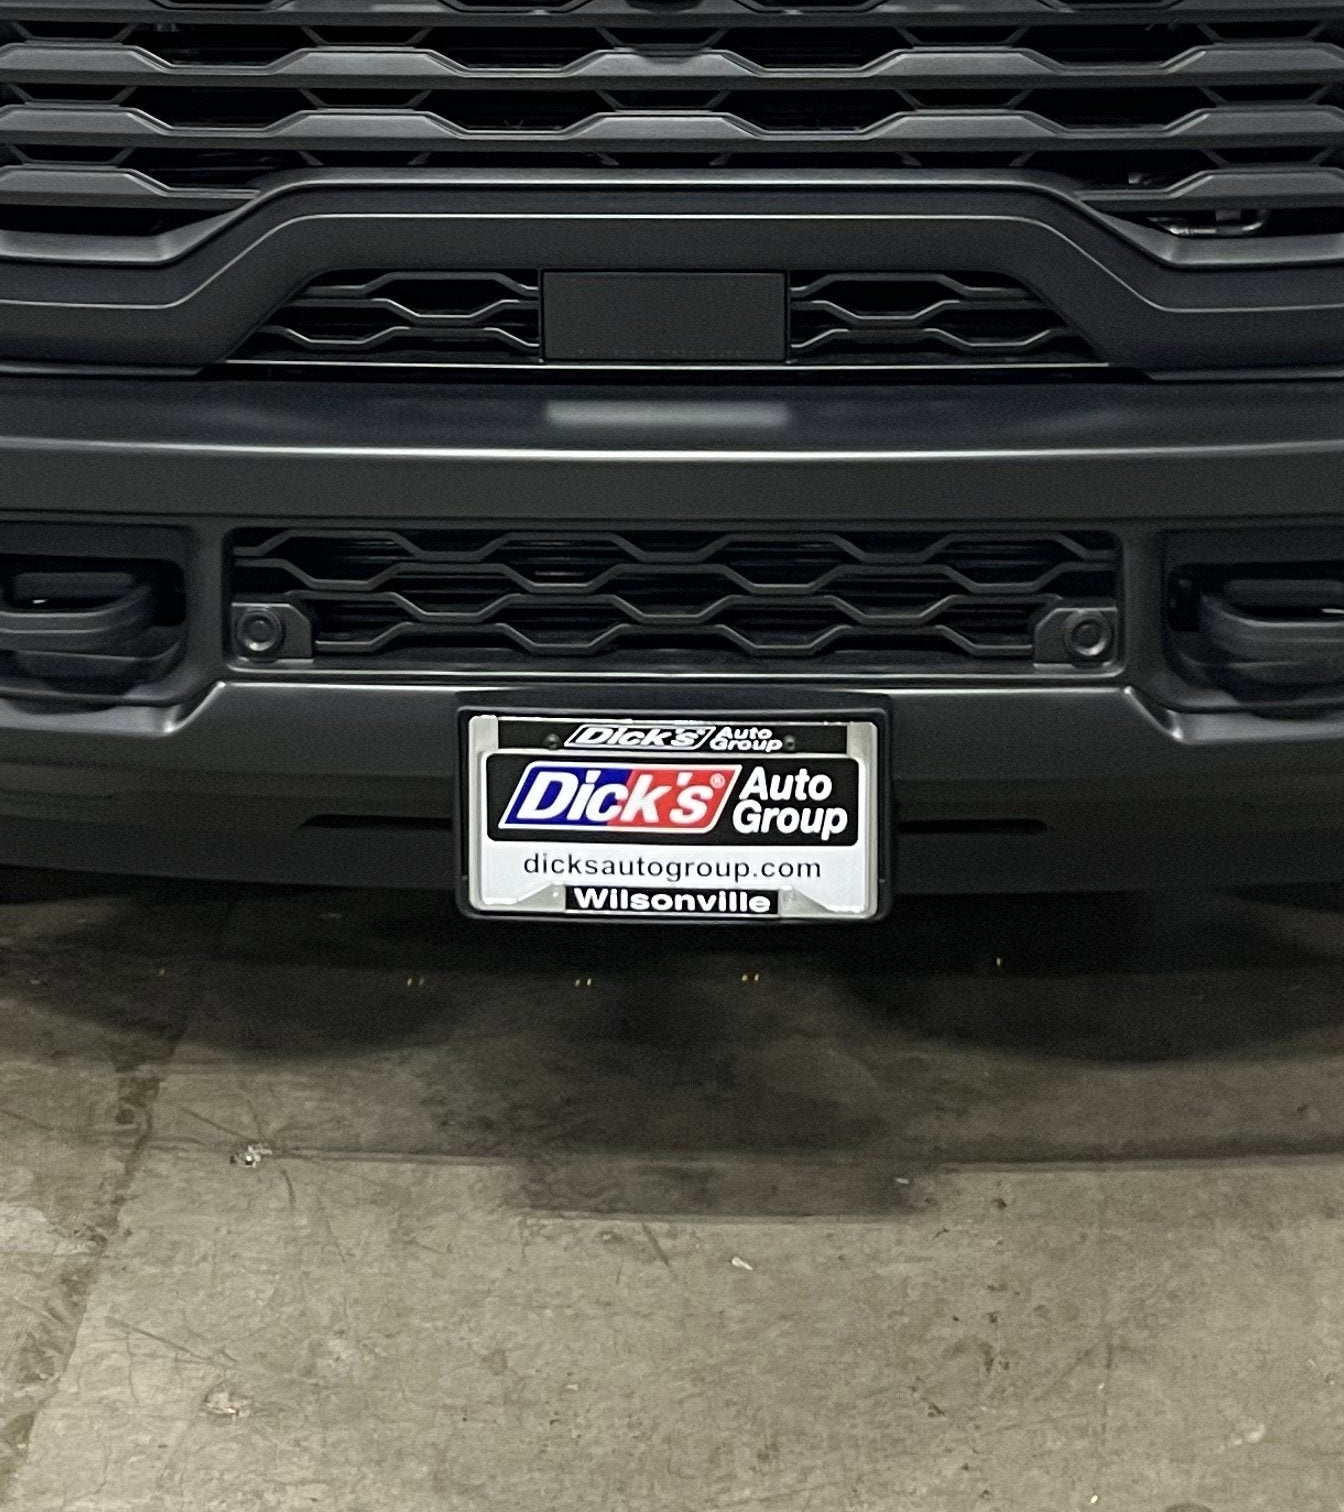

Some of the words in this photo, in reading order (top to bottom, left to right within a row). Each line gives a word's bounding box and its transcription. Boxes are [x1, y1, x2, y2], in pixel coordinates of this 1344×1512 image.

[709, 738, 783, 752] Group
[716, 727, 773, 739] Auto
[516, 769, 713, 823] Dick's
[738, 766, 832, 801] Auto
[732, 800, 848, 840] Group
[523, 853, 822, 882] dicksautogroup.com
[573, 888, 771, 914] Wilsonville
